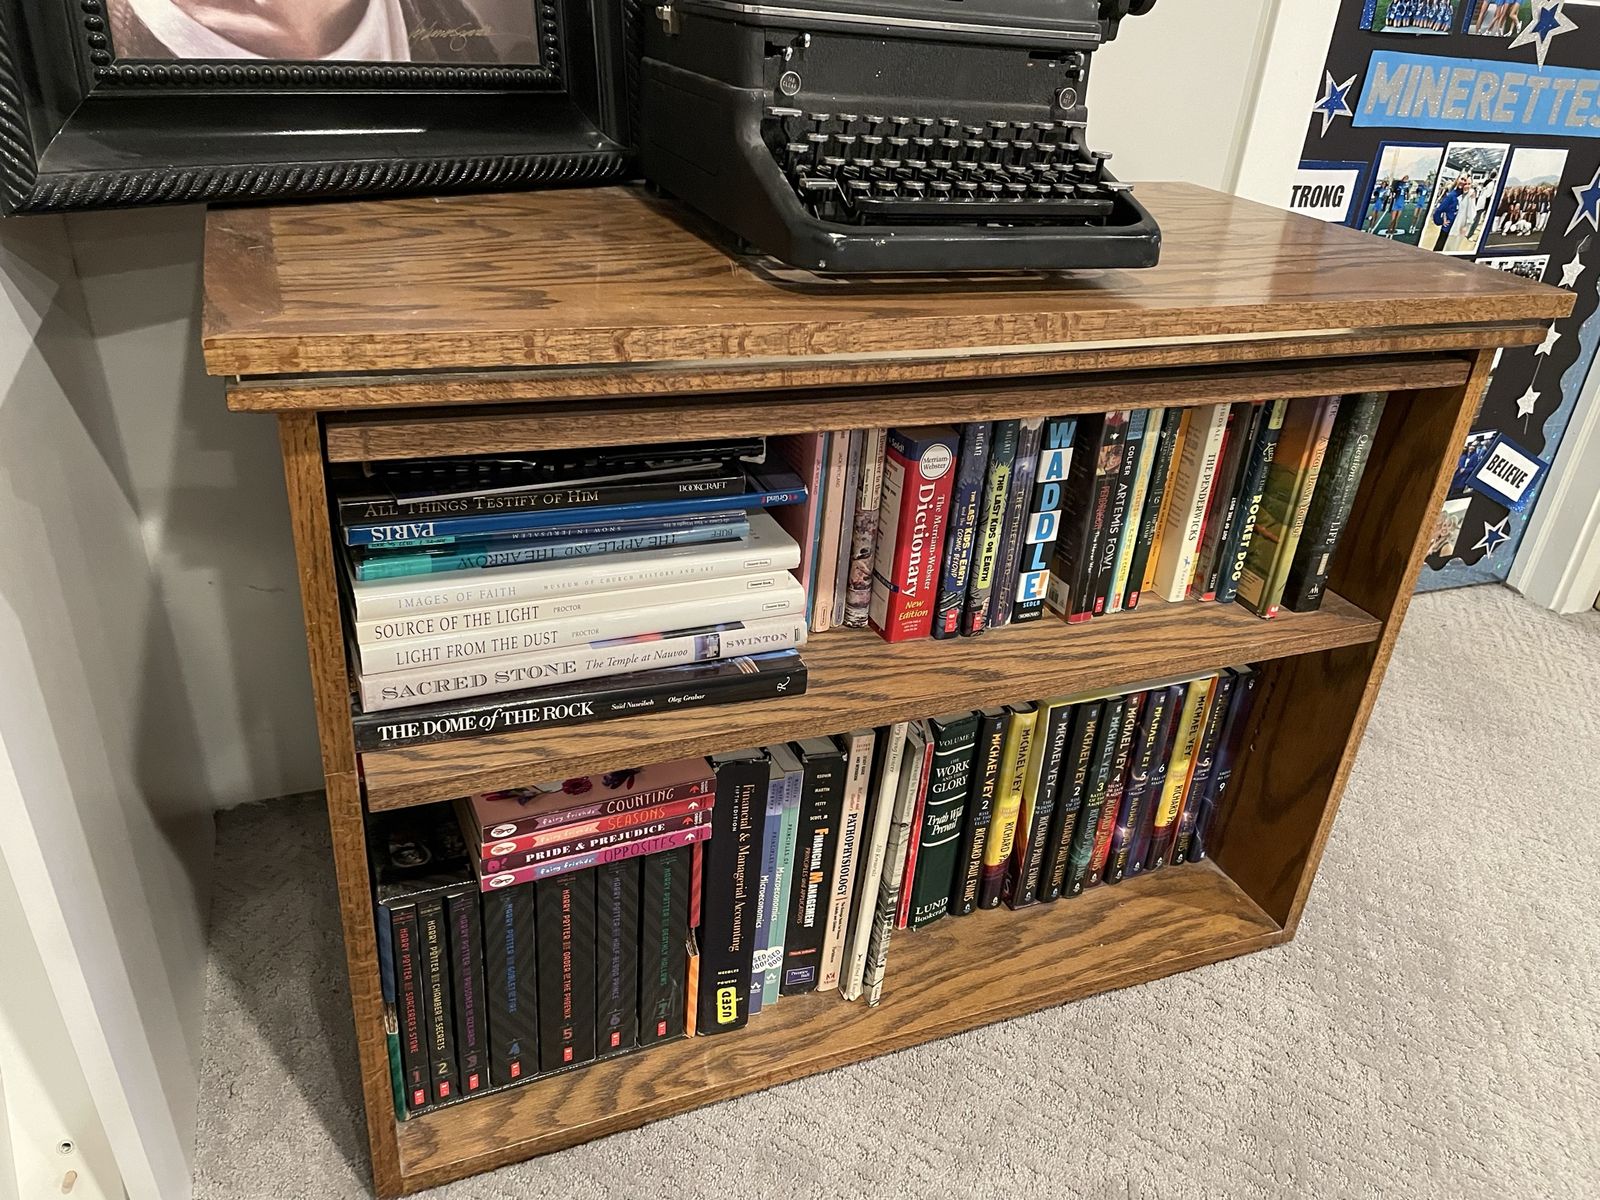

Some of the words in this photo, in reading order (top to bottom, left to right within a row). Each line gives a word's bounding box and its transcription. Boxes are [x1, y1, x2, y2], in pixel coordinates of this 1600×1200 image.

[1289, 184, 1345, 208] TRONG
[922, 455, 949, 465] Merriam-
[1123, 445, 1136, 476] COLFER
[1205, 452, 1218, 468] THE
[1263, 441, 1278, 463] Lucy
[1311, 447, 1327, 472] Year
[1346, 433, 1370, 482] Questions
[922, 462, 947, 471] Webster
[1485, 454, 1529, 490] BELIEVE
[678, 481, 728, 493] BOOKCRAFT
[995, 473, 1006, 492] THE
[1302, 473, 1320, 502] Down
[364, 503, 399, 518] ALL
[407, 500, 468, 515] THINGS
[472, 493, 538, 510] TESTIFY
[543, 493, 563, 505] OF
[567, 489, 599, 503] HIM
[936, 494, 947, 513] The
[969, 490, 978, 503] THE
[991, 493, 1004, 517] LAST
[1015, 489, 1026, 511] THE
[1188, 474, 1212, 542] PENDERWICKS
[1229, 497, 1238, 511] DUST
[966, 503, 979, 526] LAST
[1023, 420, 1077, 600] WADDLE!
[1109, 483, 1128, 534] ARTEMIS
[1226, 511, 1234, 522] THE
[1291, 502, 1311, 538] Yonder
[372, 522, 434, 541] PARIS
[594, 525, 622, 534] SNOW
[987, 517, 999, 539] KIDS
[1009, 513, 1022, 545] THIEF
[1240, 494, 1263, 548] ROCKET
[1324, 520, 1342, 545] LIFE
[512, 530, 572, 540] JERUSALEM
[598, 535, 644, 553] APPLE
[648, 533, 677, 546] THE
[902, 481, 936, 598] Dictionary
[953, 528, 965, 552] COSMIC
[962, 527, 974, 549] KIDS
[1091, 531, 1100, 542] The
[1221, 529, 1230, 541] OUT
[524, 547, 556, 561] THE
[564, 541, 592, 556] AND
[923, 513, 945, 590] Merriam-Webster
[1099, 537, 1117, 573] FOWL
[456, 552, 524, 570] ARROW
[951, 552, 961, 577] BEYOND
[956, 558, 970, 587] EARTH
[980, 555, 995, 582] EARTH
[1003, 546, 1015, 576] LORD
[1231, 550, 1248, 582] DOG
[398, 594, 449, 609] IMAGES
[456, 591, 472, 602] OF
[480, 586, 517, 600] FAITH
[552, 603, 582, 615] PROCTOR
[904, 599, 925, 610] New
[375, 620, 434, 640] SOURCE
[439, 616, 459, 631] OF
[463, 611, 491, 628] THE
[497, 605, 539, 624] LIGHT
[898, 608, 929, 621] Edition
[571, 627, 600, 638] PROCTOR
[725, 632, 789, 649] SWINTON
[396, 646, 441, 666] LIGHT
[447, 641, 486, 659] FROM
[491, 636, 519, 652] THE
[523, 630, 559, 648] DUST
[585, 659, 605, 671] The
[606, 654, 639, 670] Temple
[641, 653, 652, 662] at
[653, 648, 689, 660] Nauvoo
[381, 673, 488, 701] SACRED
[494, 660, 577, 684] STONE
[667, 695, 683, 704] Oleg
[682, 692, 706, 703] Grabar
[377, 723, 420, 741] THE
[422, 715, 478, 736] DOME
[478, 707, 503, 732] of
[501, 708, 540, 726] THE
[543, 700, 595, 720] ROCK
[939, 734, 971, 747] VOLUME
[1015, 727, 1031, 772] MICHAEL
[1050, 721, 1068, 766] MICHAEL
[985, 733, 1003, 778] MICHAEL
[1202, 757, 1210, 767] 5
[935, 760, 971, 779] WORK
[1046, 766, 1059, 788] VEY
[1158, 763, 1166, 774] 6
[932, 773, 970, 794] GLORY
[982, 779, 994, 799] VEY
[1011, 772, 1024, 793] VEY
[1046, 789, 1052, 799] 1
[1219, 781, 1226, 793] 9
[606, 787, 675, 814] COUNTING
[739, 784, 756, 830] Financial
[981, 800, 990, 811] 2
[607, 806, 666, 830] SEASONS
[927, 811, 950, 827] Truth
[948, 805, 965, 821] Will
[931, 818, 959, 837] Prevail
[525, 844, 572, 863] PRIDE
[575, 841, 586, 851] &
[589, 823, 666, 849] PREJUDICE
[738, 832, 750, 842] &
[971, 827, 986, 860] RICHARD
[603, 836, 676, 863] OPPOSITES
[809, 827, 829, 871] FINANCIAL
[836, 812, 858, 896] PATHOPHYSIOLOGY
[732, 844, 751, 899] Managerial
[968, 860, 981, 879] PAUL
[562, 889, 571, 911] HARRY
[755, 875, 770, 929] Microeconomics
[771, 866, 785, 922] Macroeconomics
[803, 871, 825, 928] MANAGEMENT
[963, 879, 977, 902] EVANS
[914, 905, 948, 923] Bookcraft
[915, 896, 949, 915] LUND
[427, 919, 437, 944] HARRY
[563, 914, 571, 940] POTTER
[728, 900, 746, 952] Accounting
[399, 927, 409, 951] HARRY
[401, 954, 413, 981] POTTER
[429, 945, 440, 972] POTTER
[563, 951, 571, 972] ORDER
[431, 983, 443, 1015] CHAMBER
[563, 992, 572, 1019] PHOENIX
[721, 989, 733, 1019] USED
[408, 1032, 419, 1054] STONE
[434, 1022, 446, 1050] SECRETS
[563, 1027, 573, 1040] 5
[437, 1062, 448, 1075] 2
